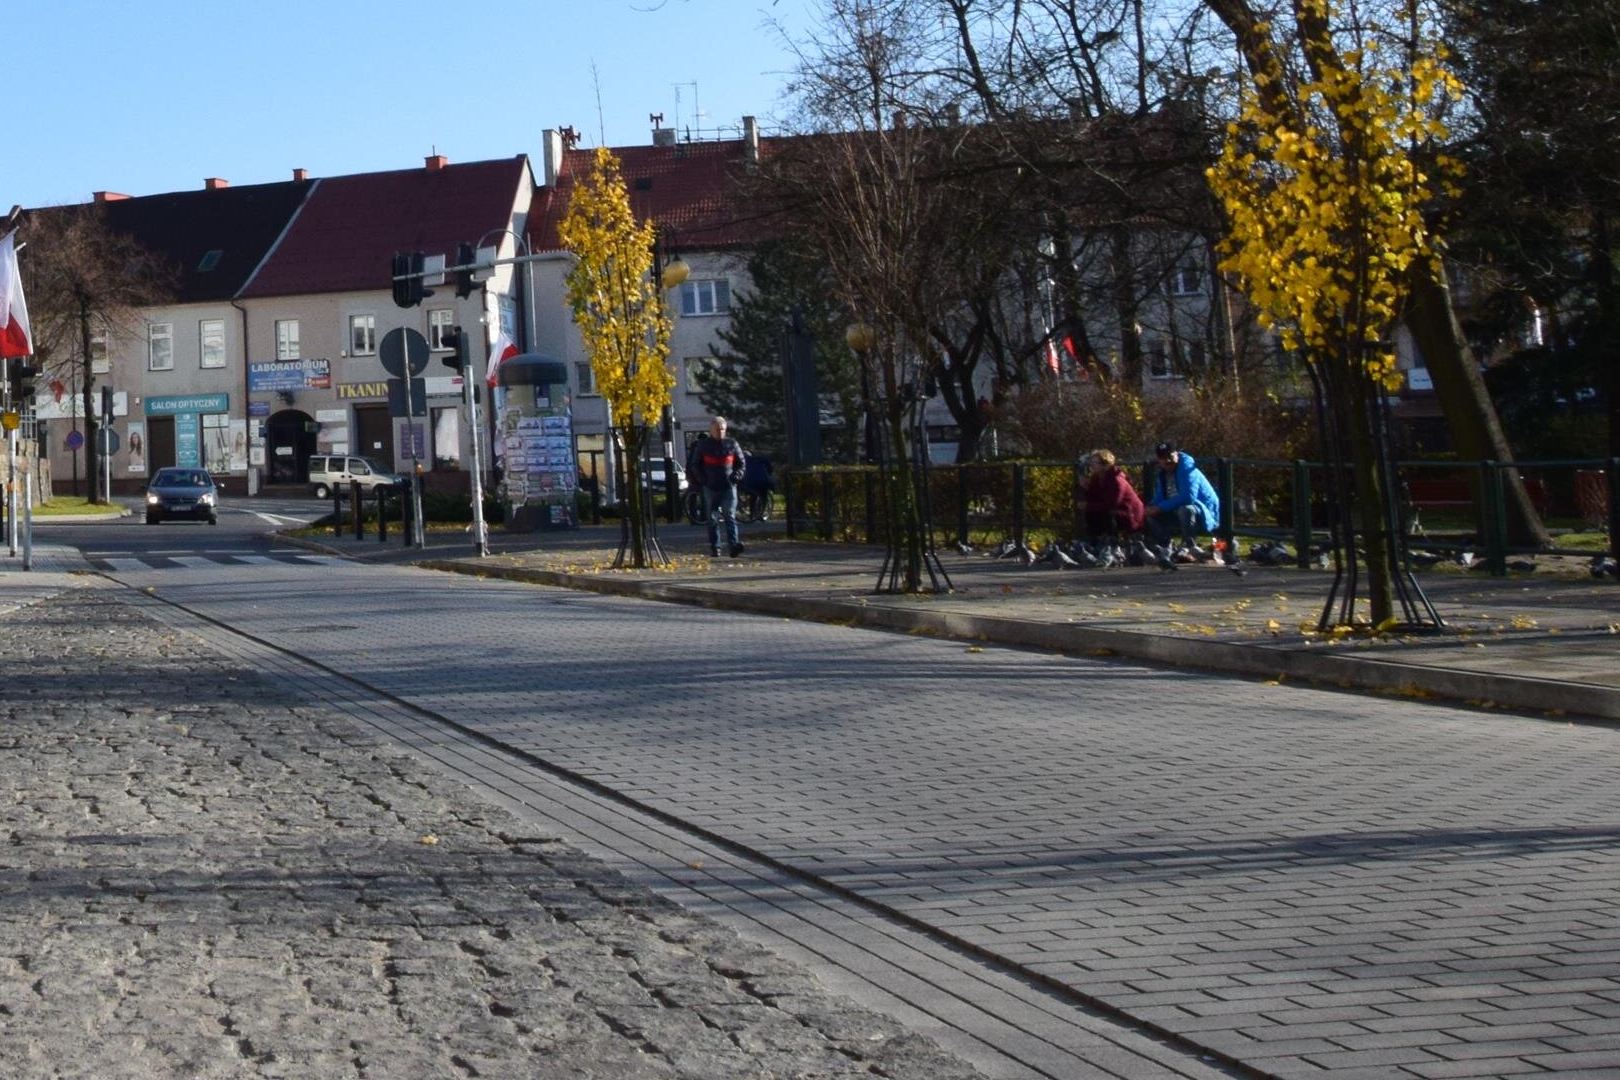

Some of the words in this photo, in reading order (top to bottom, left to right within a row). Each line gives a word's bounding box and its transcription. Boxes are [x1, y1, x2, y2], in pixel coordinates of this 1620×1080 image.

[251, 360, 328, 373] LABORATORIUM
[151, 401, 177, 410] SALON
[178, 399, 220, 409] OPTYCZNY
